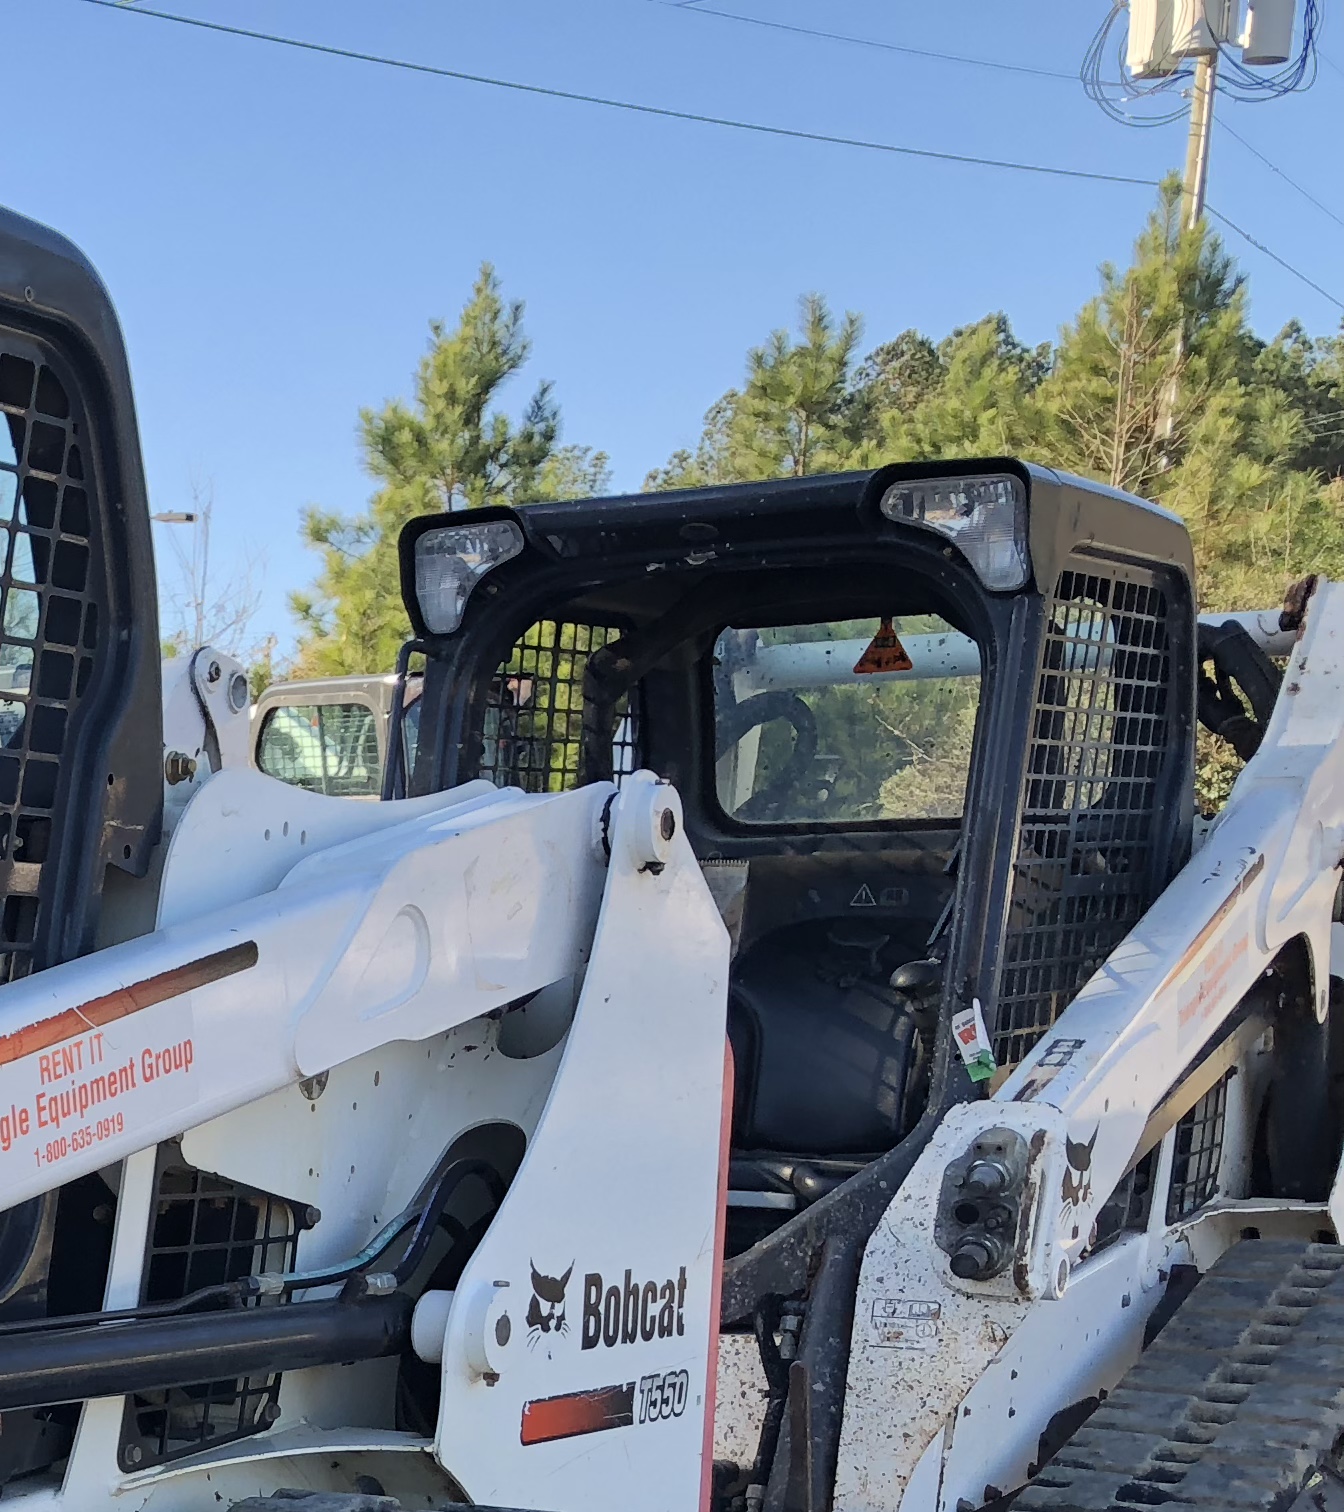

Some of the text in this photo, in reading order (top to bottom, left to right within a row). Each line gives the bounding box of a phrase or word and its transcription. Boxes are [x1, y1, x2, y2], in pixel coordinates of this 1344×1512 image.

[36, 1057, 136, 1129] Equipment
[140, 1038, 194, 1082] Group
[38, 1032, 104, 1085] RENT IT
[33, 1112, 125, 1168] 1-800-635-0919
[581, 1266, 687, 1350] Bobcat
[639, 1369, 689, 1425] T550
